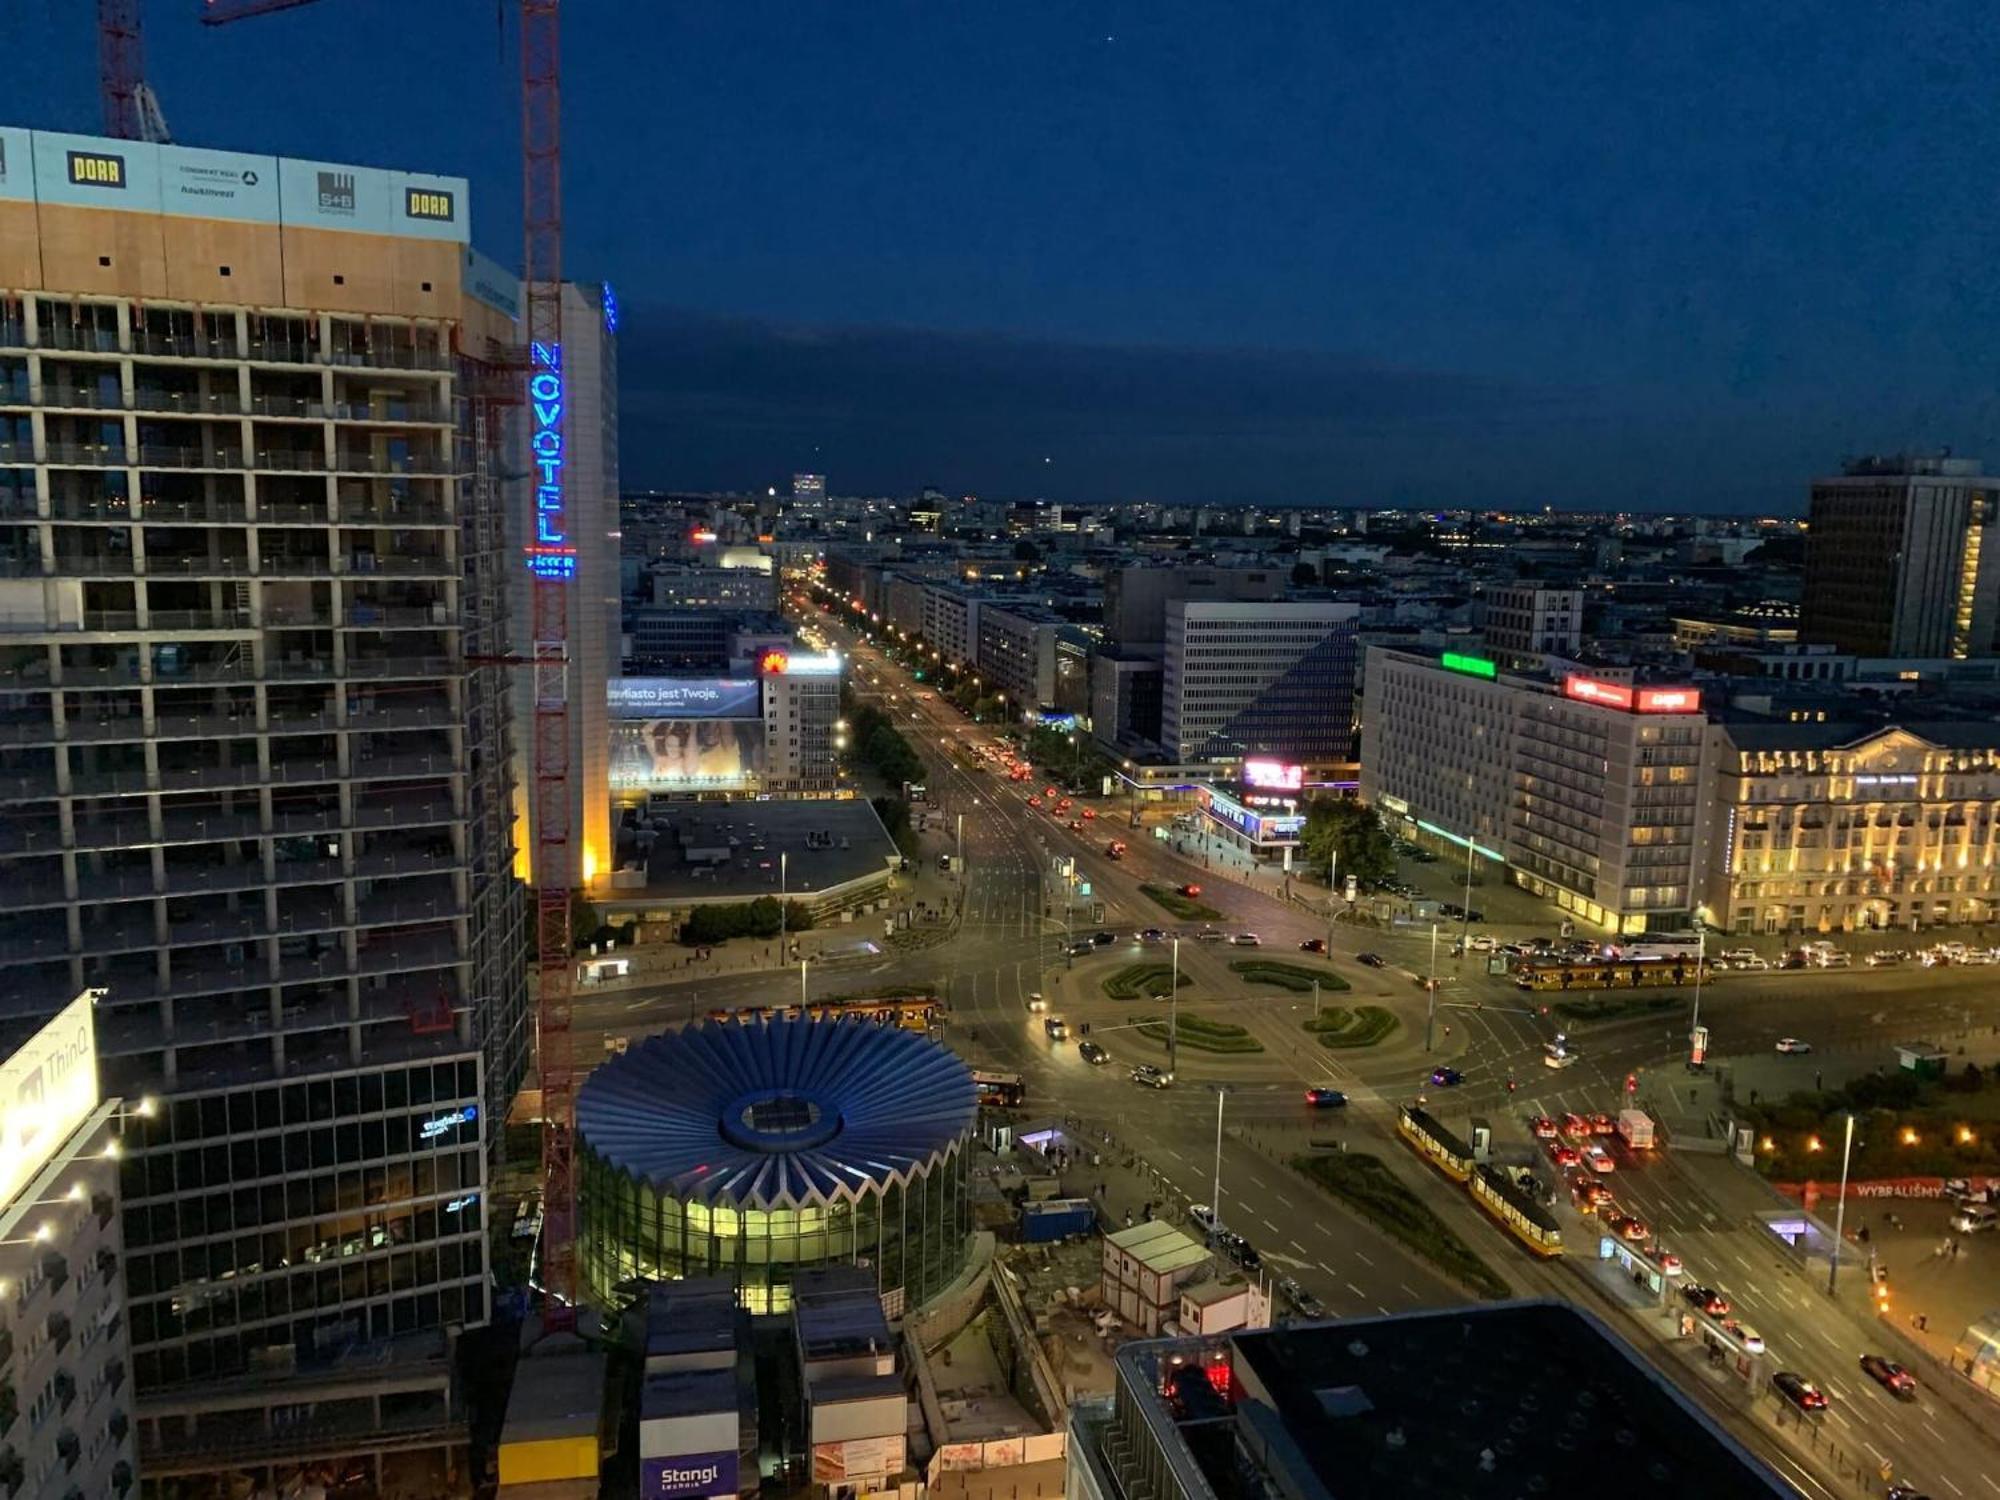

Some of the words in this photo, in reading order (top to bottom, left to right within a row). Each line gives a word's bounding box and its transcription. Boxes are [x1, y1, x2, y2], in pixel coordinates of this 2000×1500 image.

[530, 342, 563, 542] NOVOTEL
[657, 688, 679, 700] jest
[681, 687, 719, 701] Twoje.
[46, 1026, 89, 1085] ThinQ
[661, 1465, 718, 1484] Stangl
